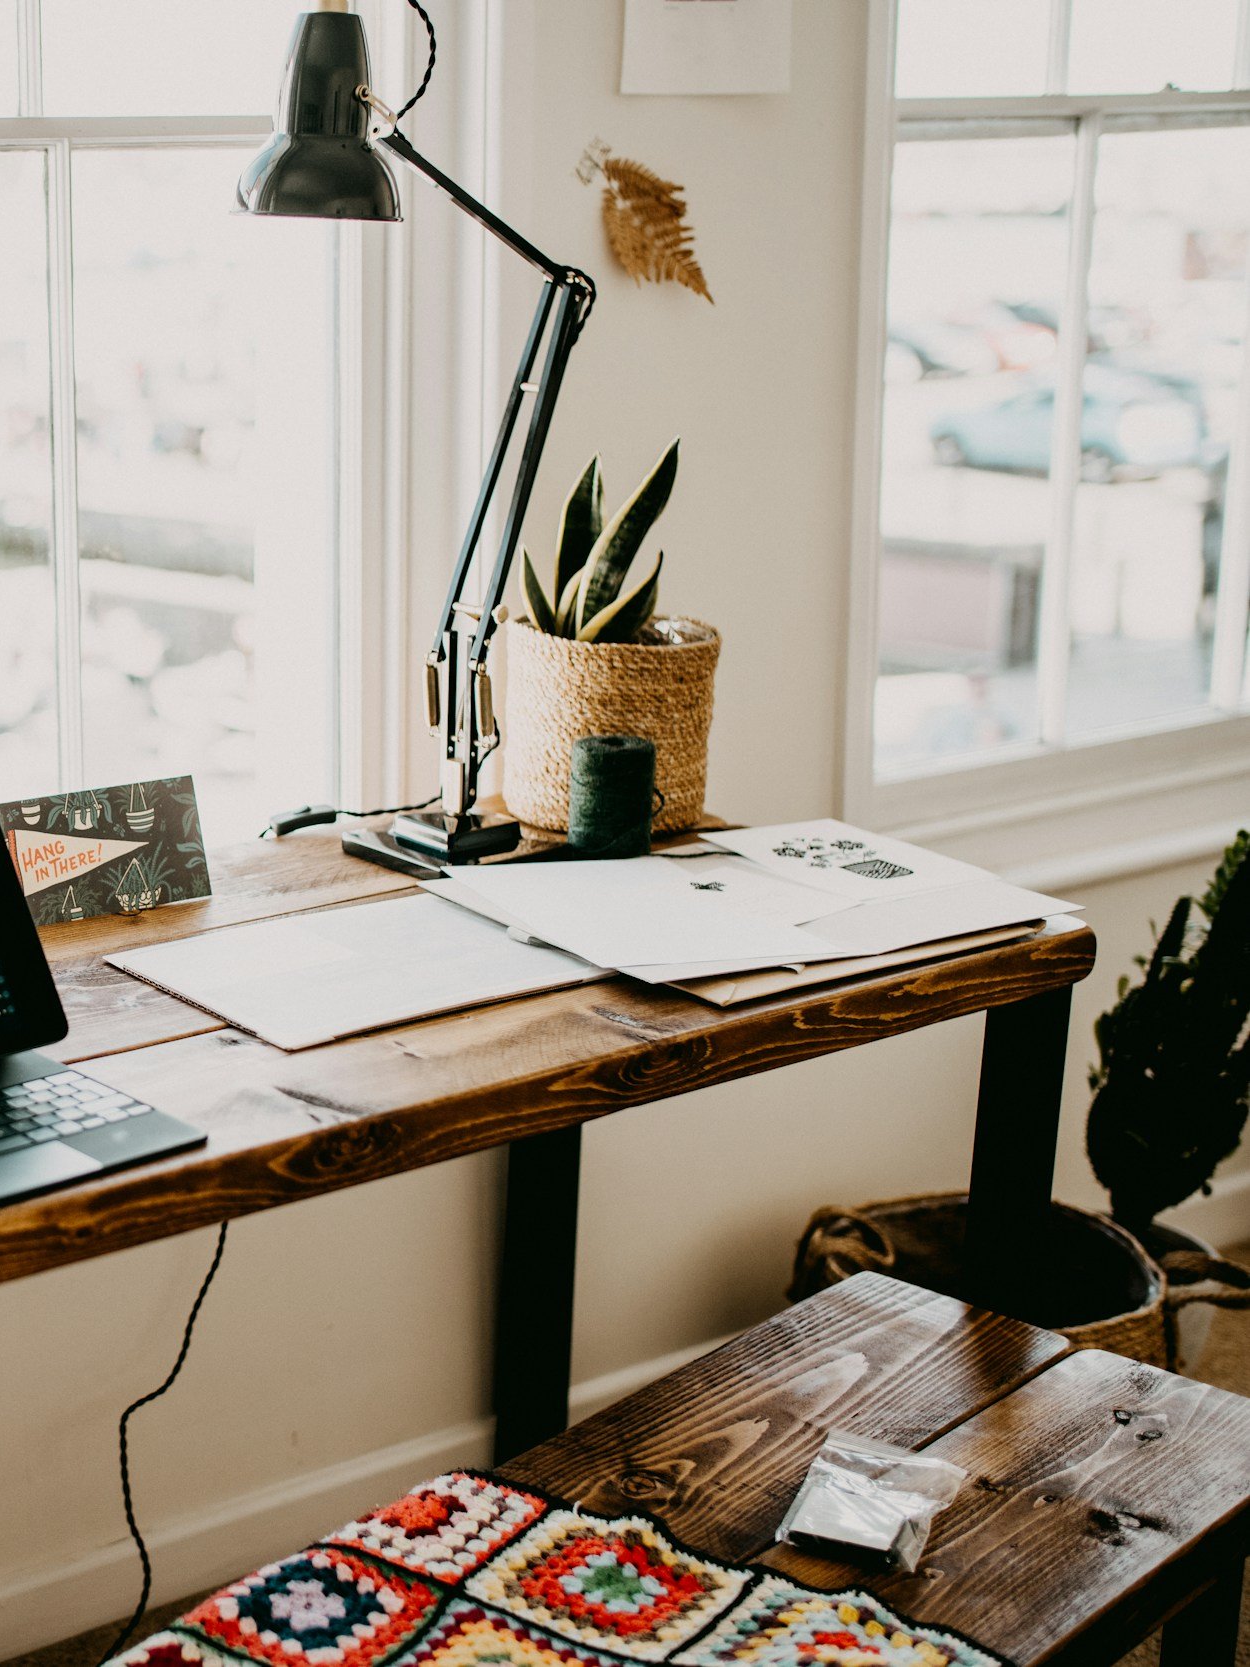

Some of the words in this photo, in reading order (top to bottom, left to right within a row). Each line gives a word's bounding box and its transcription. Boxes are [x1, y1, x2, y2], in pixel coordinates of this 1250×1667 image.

[21, 840, 65, 873] HANG
[35, 866, 50, 883] IN
[48, 842, 103, 878] THERE!
